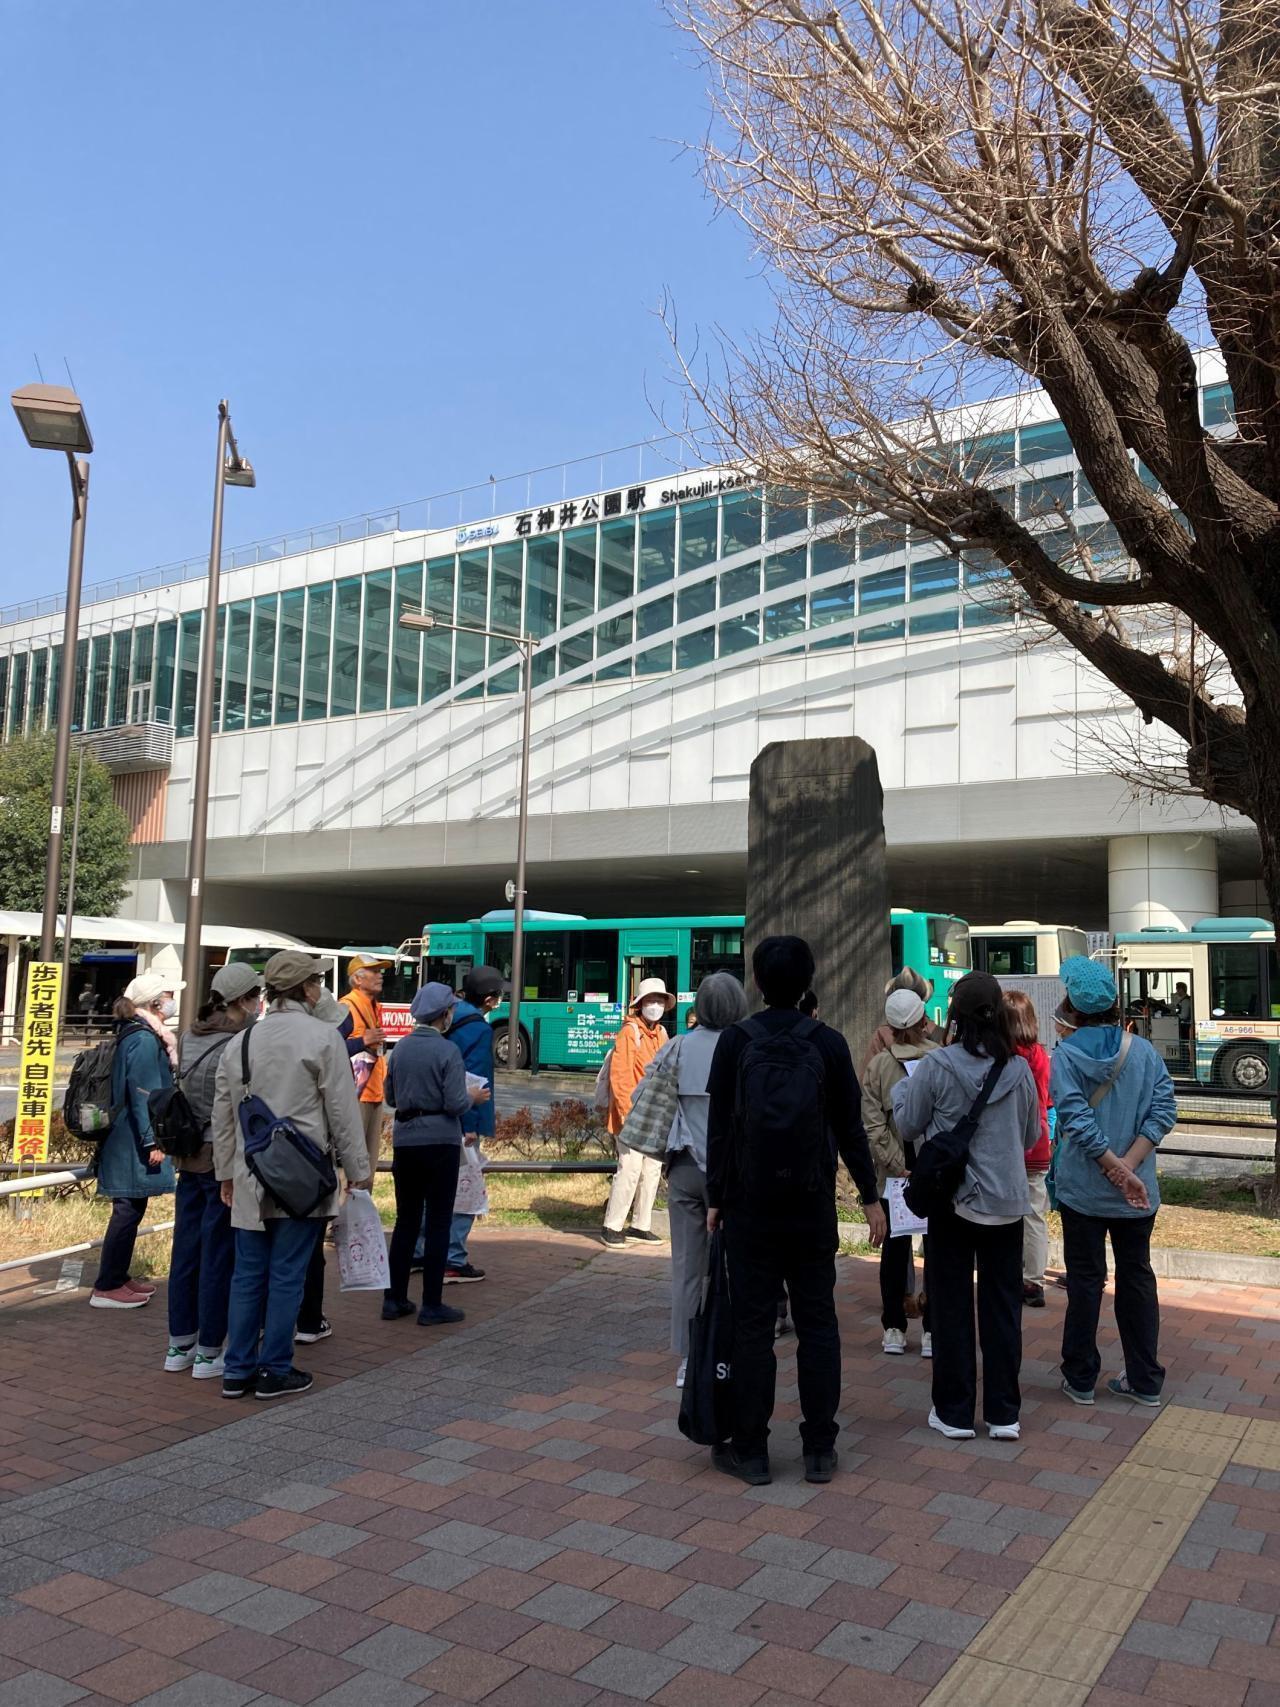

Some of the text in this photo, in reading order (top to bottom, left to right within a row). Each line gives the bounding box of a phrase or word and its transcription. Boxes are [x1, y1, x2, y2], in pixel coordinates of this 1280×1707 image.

[516, 486, 647, 536] 石神井公園駅
[468, 525, 500, 540] SEIBU
[26, 964, 59, 1056] 歩行者優先
[1224, 1026, 1253, 1034] A6-966
